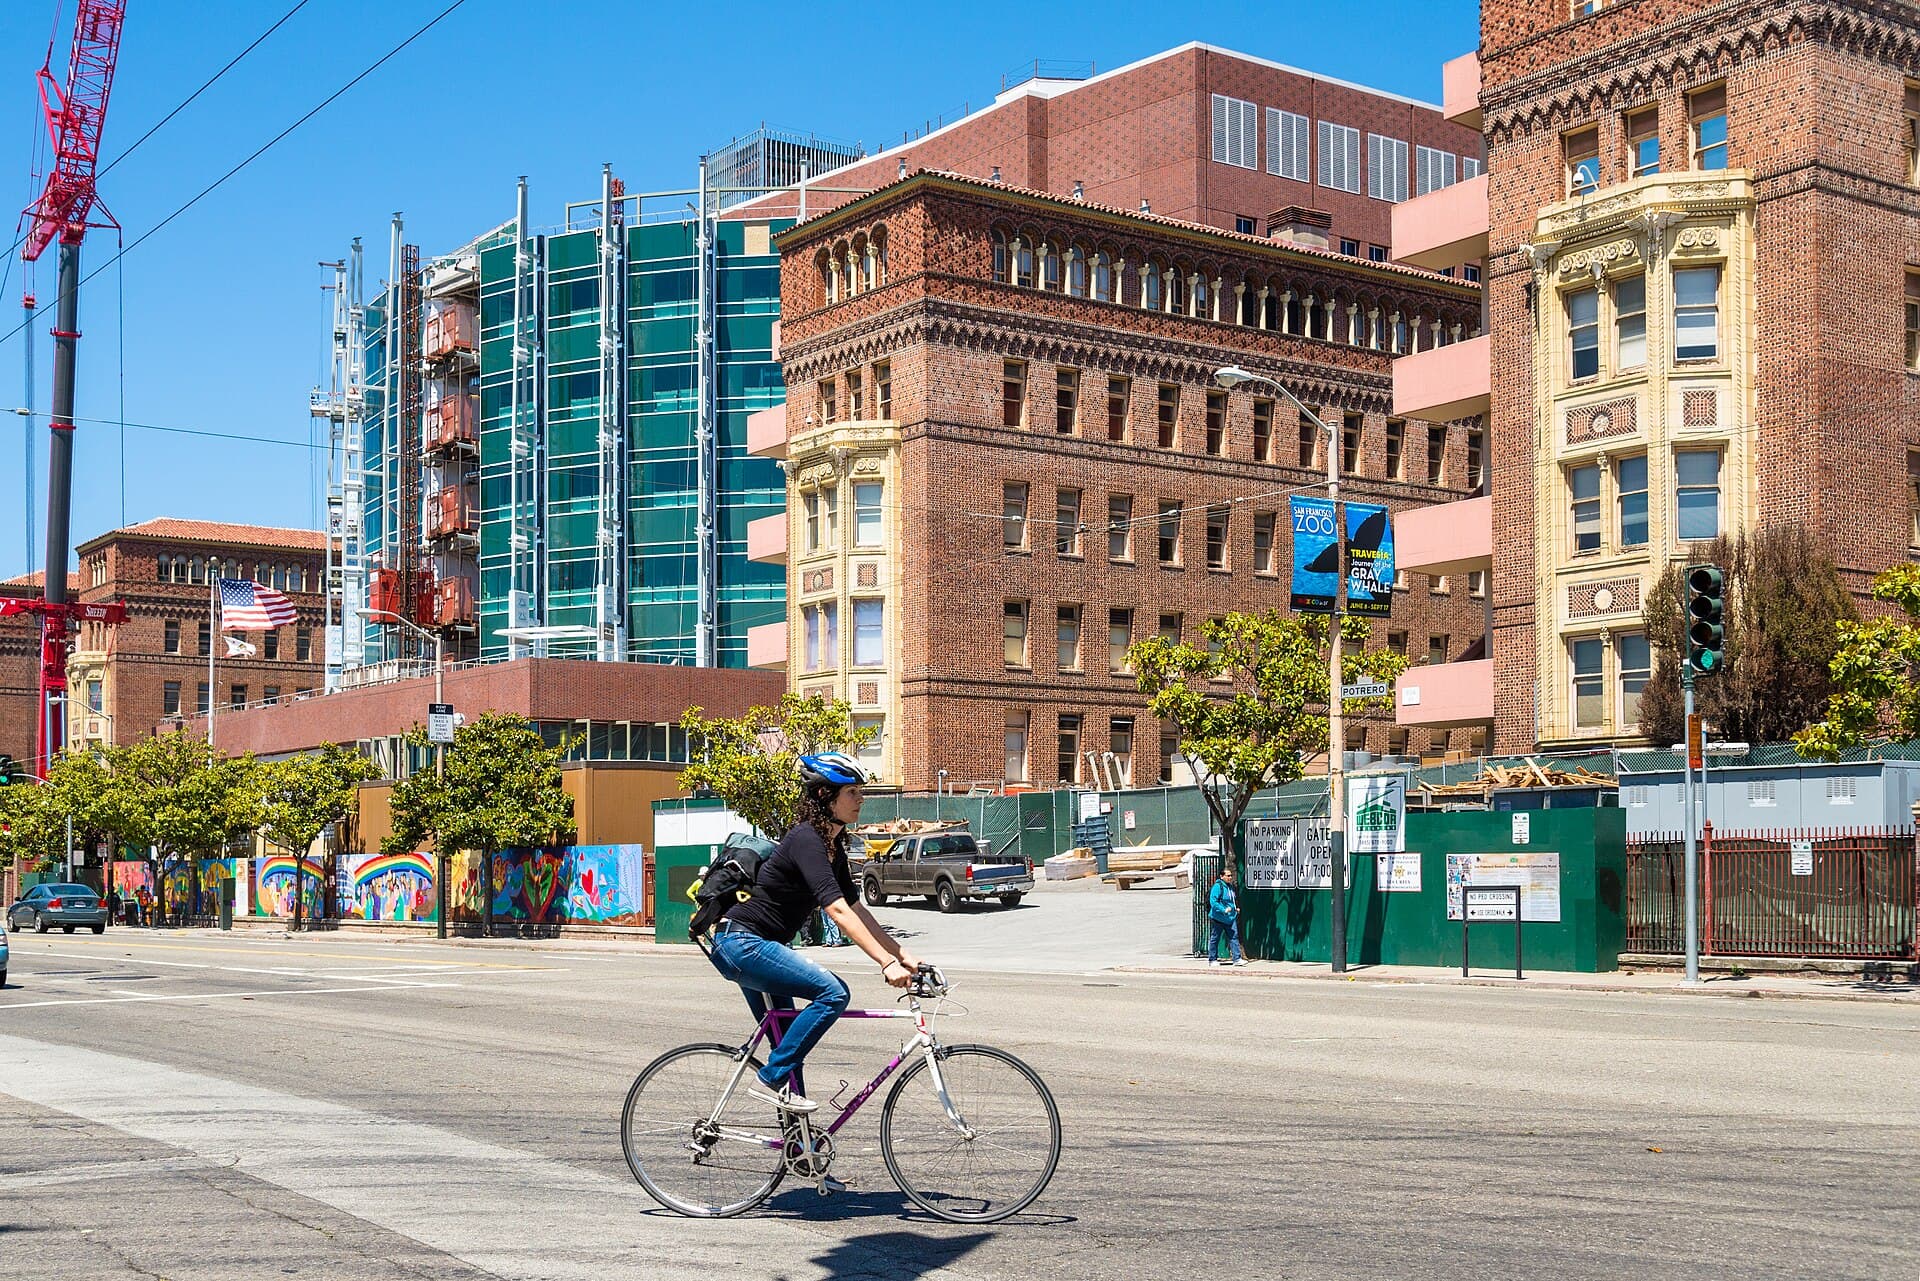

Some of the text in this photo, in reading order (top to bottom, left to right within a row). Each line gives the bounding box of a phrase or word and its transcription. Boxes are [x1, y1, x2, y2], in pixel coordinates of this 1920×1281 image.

[1294, 506, 1332, 518] SAN FRANCISCO
[1295, 515, 1334, 534] ZOO
[1351, 559, 1374, 569] Journey
[1351, 568, 1381, 580] GRAY
[1351, 580, 1391, 594] WHALE
[1343, 685, 1385, 696] POTRERO
[1356, 811, 1397, 826] WEBCOR
[1250, 826, 1291, 837] NO PARKING
[1254, 841, 1287, 851] NO IDLING
[1248, 856, 1293, 866] CITATIONS WILL
[1253, 870, 1289, 880] BE ISSUED
[1300, 865, 1309, 877] AT
[1313, 865, 1332, 877] 7:00
